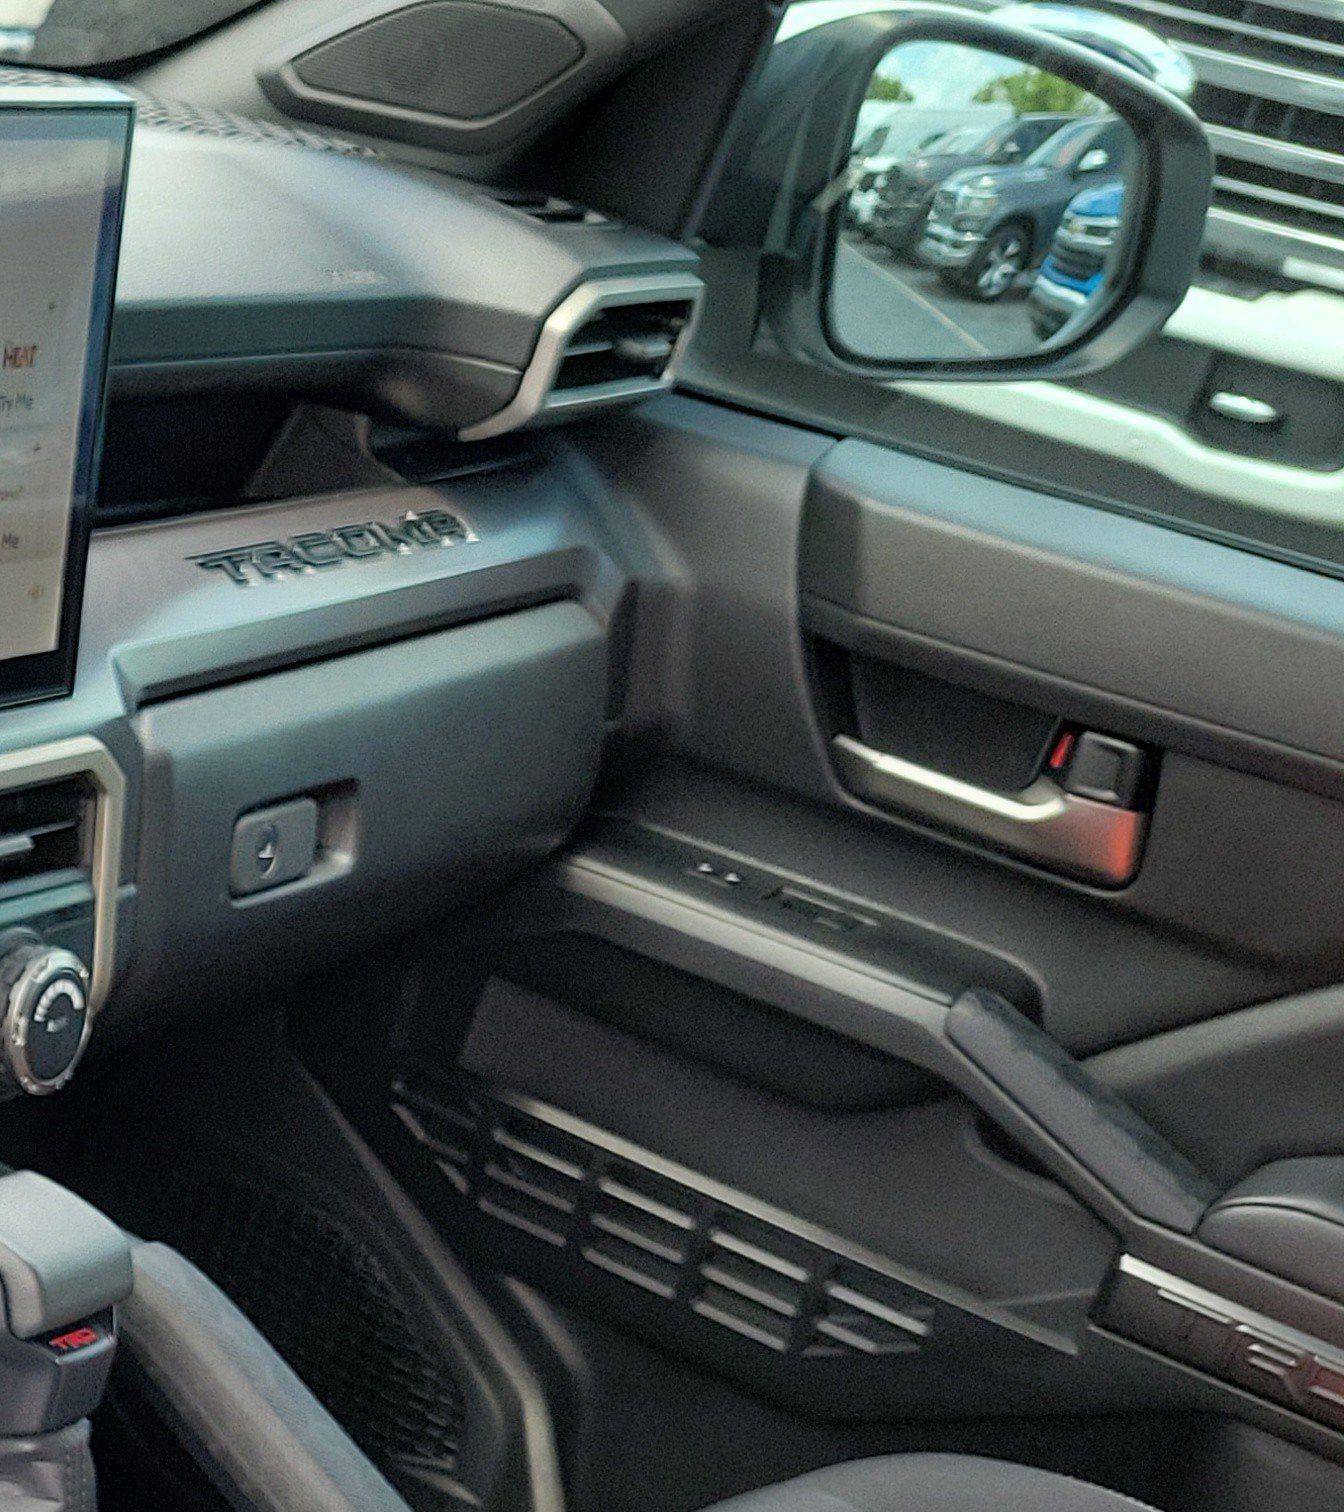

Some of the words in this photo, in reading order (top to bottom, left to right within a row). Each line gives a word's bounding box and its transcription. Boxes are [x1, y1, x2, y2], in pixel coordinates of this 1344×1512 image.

[15, 393, 33, 410] Me
[2, 532, 20, 549] Me
[184, 508, 480, 587] TACOMA
